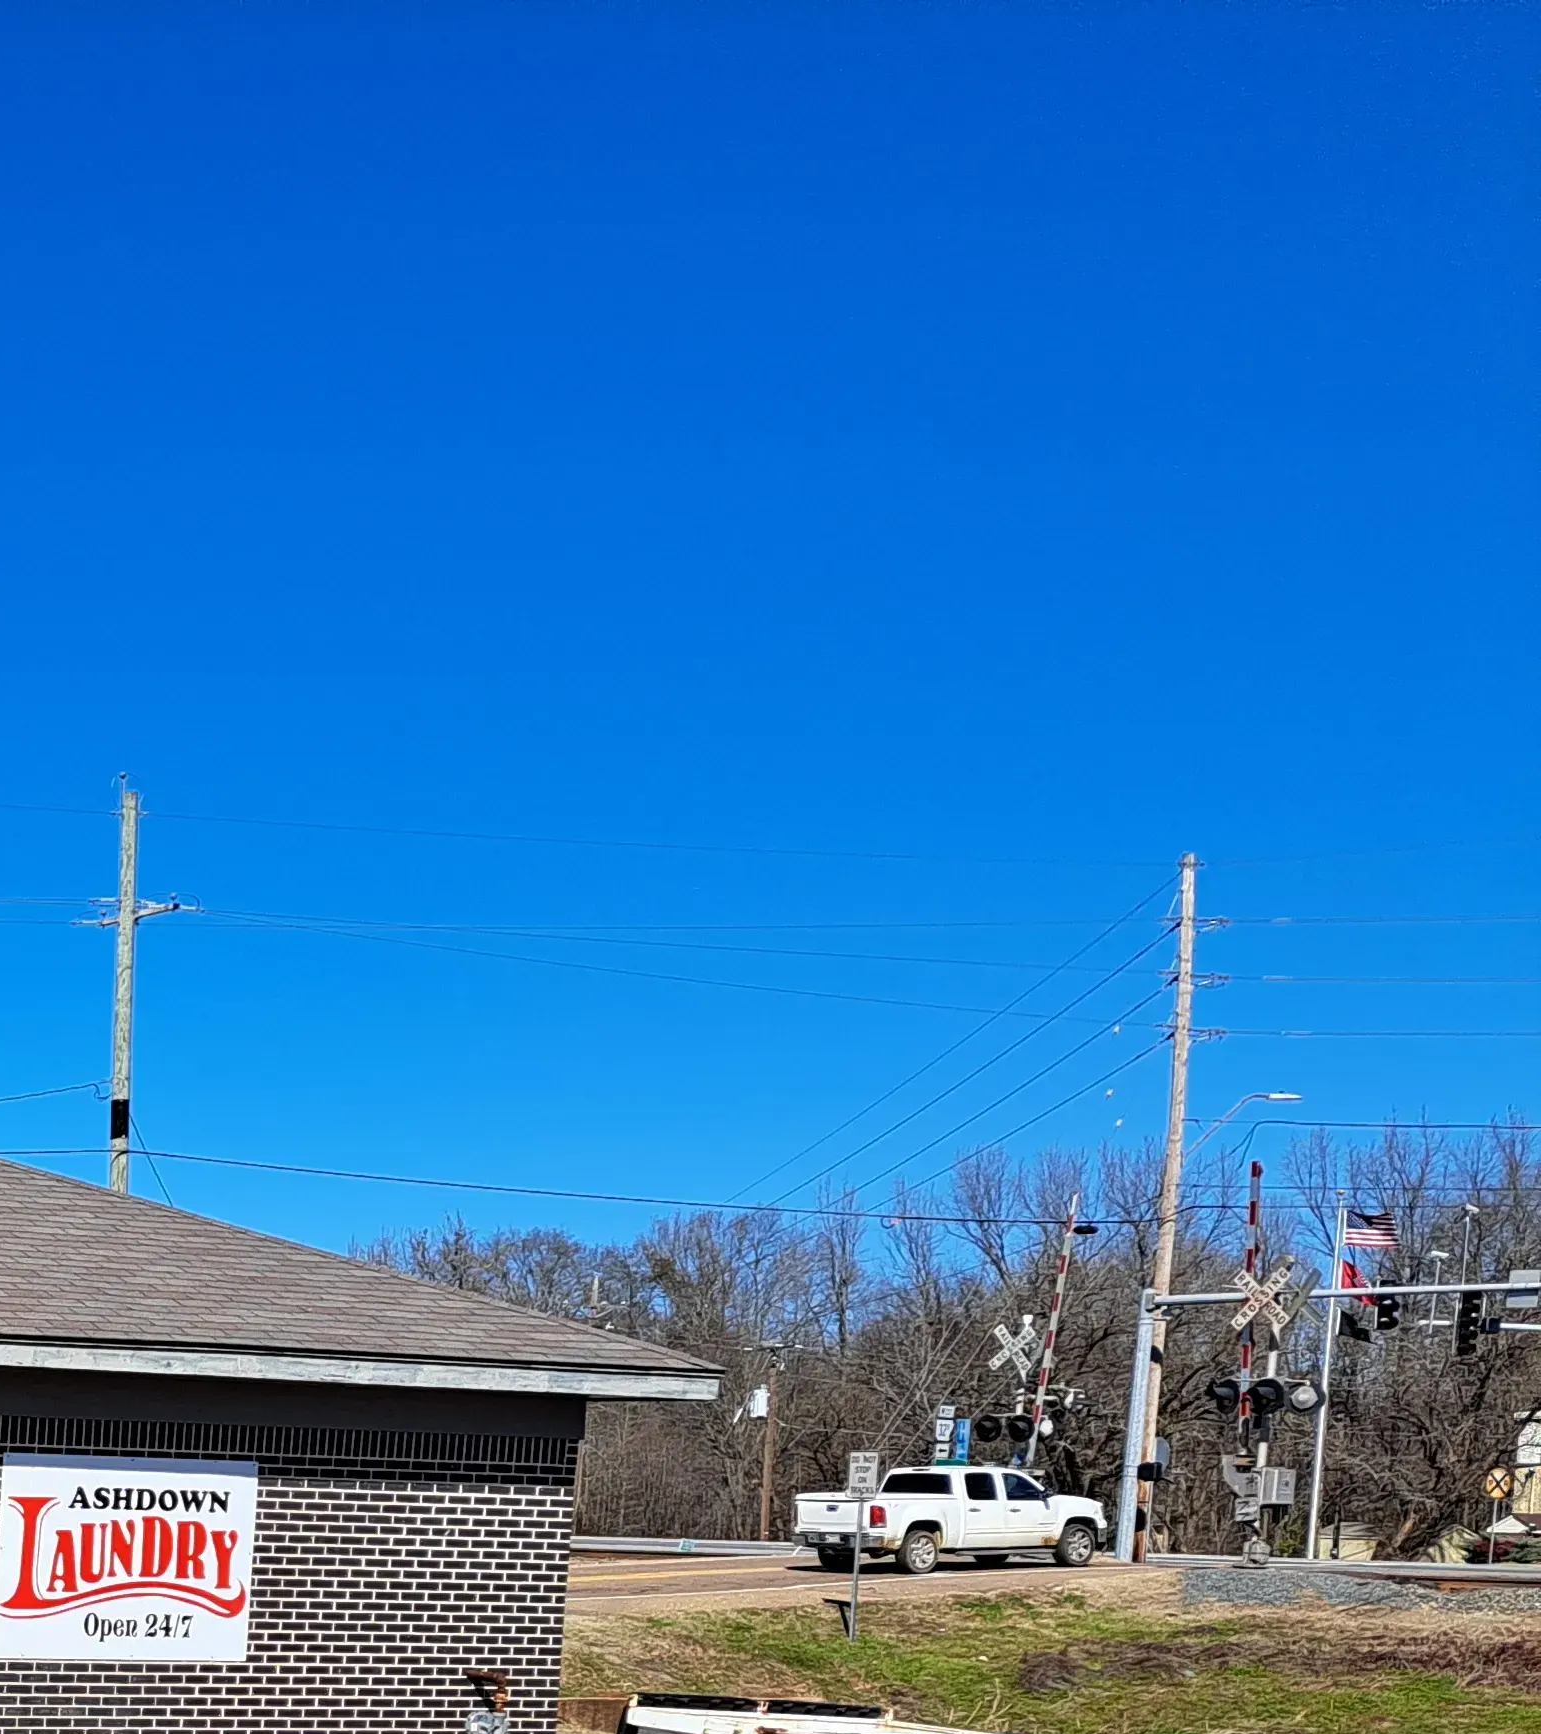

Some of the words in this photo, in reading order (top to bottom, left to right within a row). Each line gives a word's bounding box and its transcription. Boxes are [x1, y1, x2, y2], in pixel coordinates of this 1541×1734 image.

[1237, 1271, 1288, 1327] CROSSING
[67, 1485, 232, 1513] ASHDOWN
[0, 1496, 240, 1609] LAUNDRY
[83, 1611, 139, 1642] Open
[144, 1613, 195, 1639] 24/7
